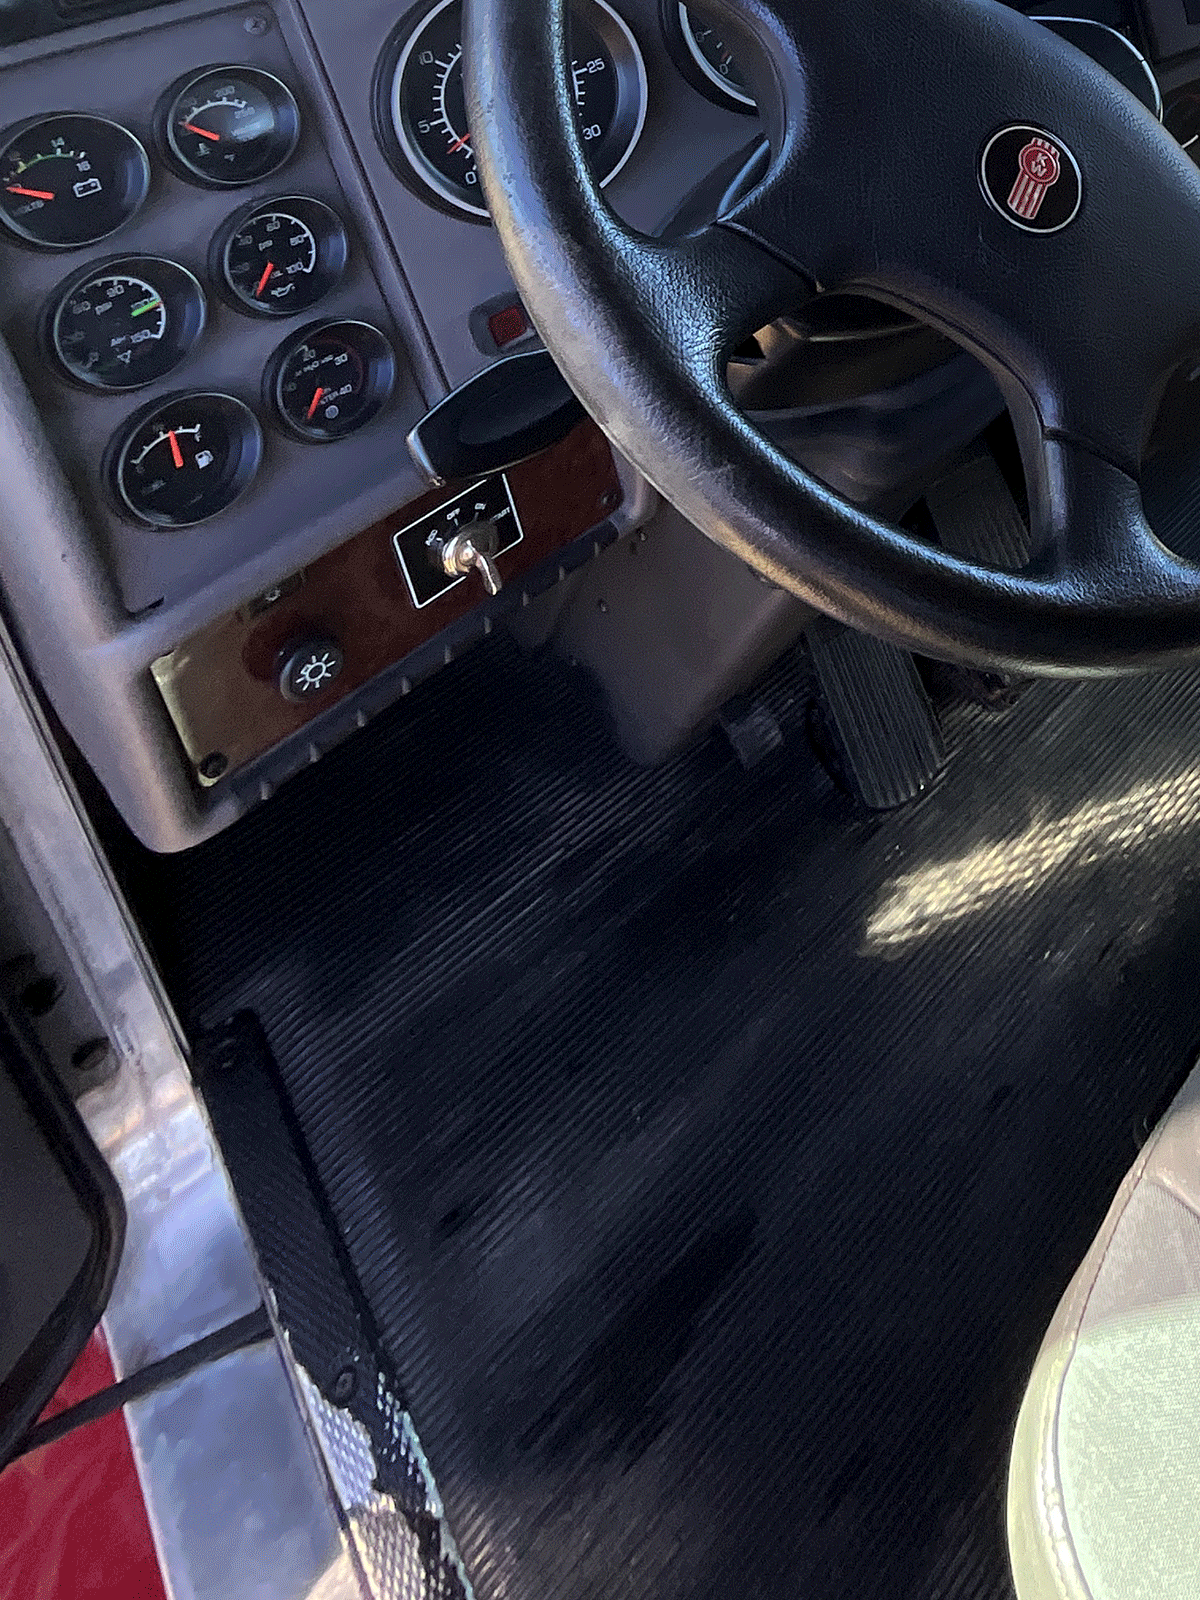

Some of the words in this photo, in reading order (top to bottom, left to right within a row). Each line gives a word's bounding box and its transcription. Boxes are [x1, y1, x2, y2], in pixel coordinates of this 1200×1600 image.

[586, 58, 606, 74] 25
[418, 121, 430, 134] 5
[582, 124, 602, 141] 30
[334, 353, 348, 366] 30
